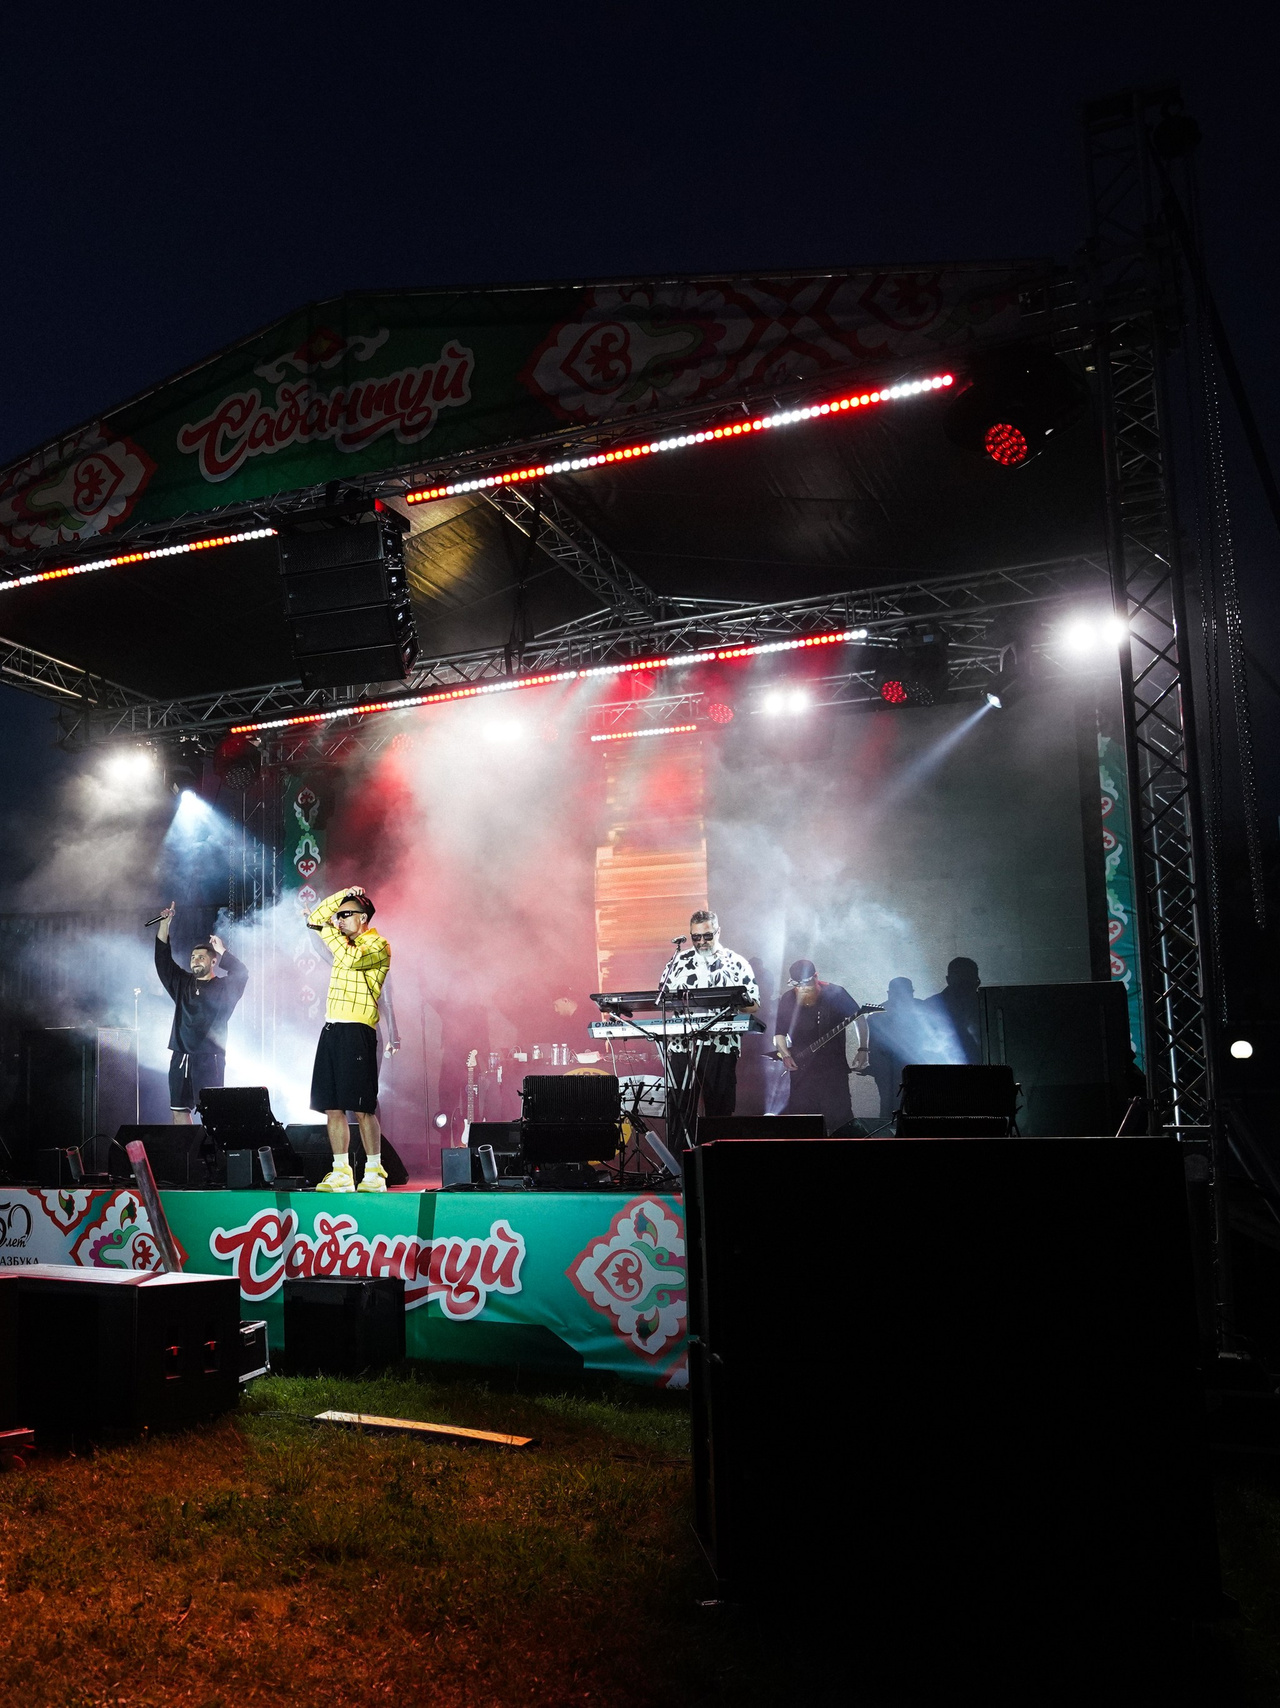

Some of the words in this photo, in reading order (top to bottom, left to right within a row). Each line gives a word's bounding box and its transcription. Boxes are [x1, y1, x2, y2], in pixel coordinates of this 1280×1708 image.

[179, 343, 472, 479] Сабантуй
[0, 1256, 39, 1266] АЗБУКА
[3, 1235, 27, 1248] лет
[213, 1210, 523, 1318] Сабантуй
